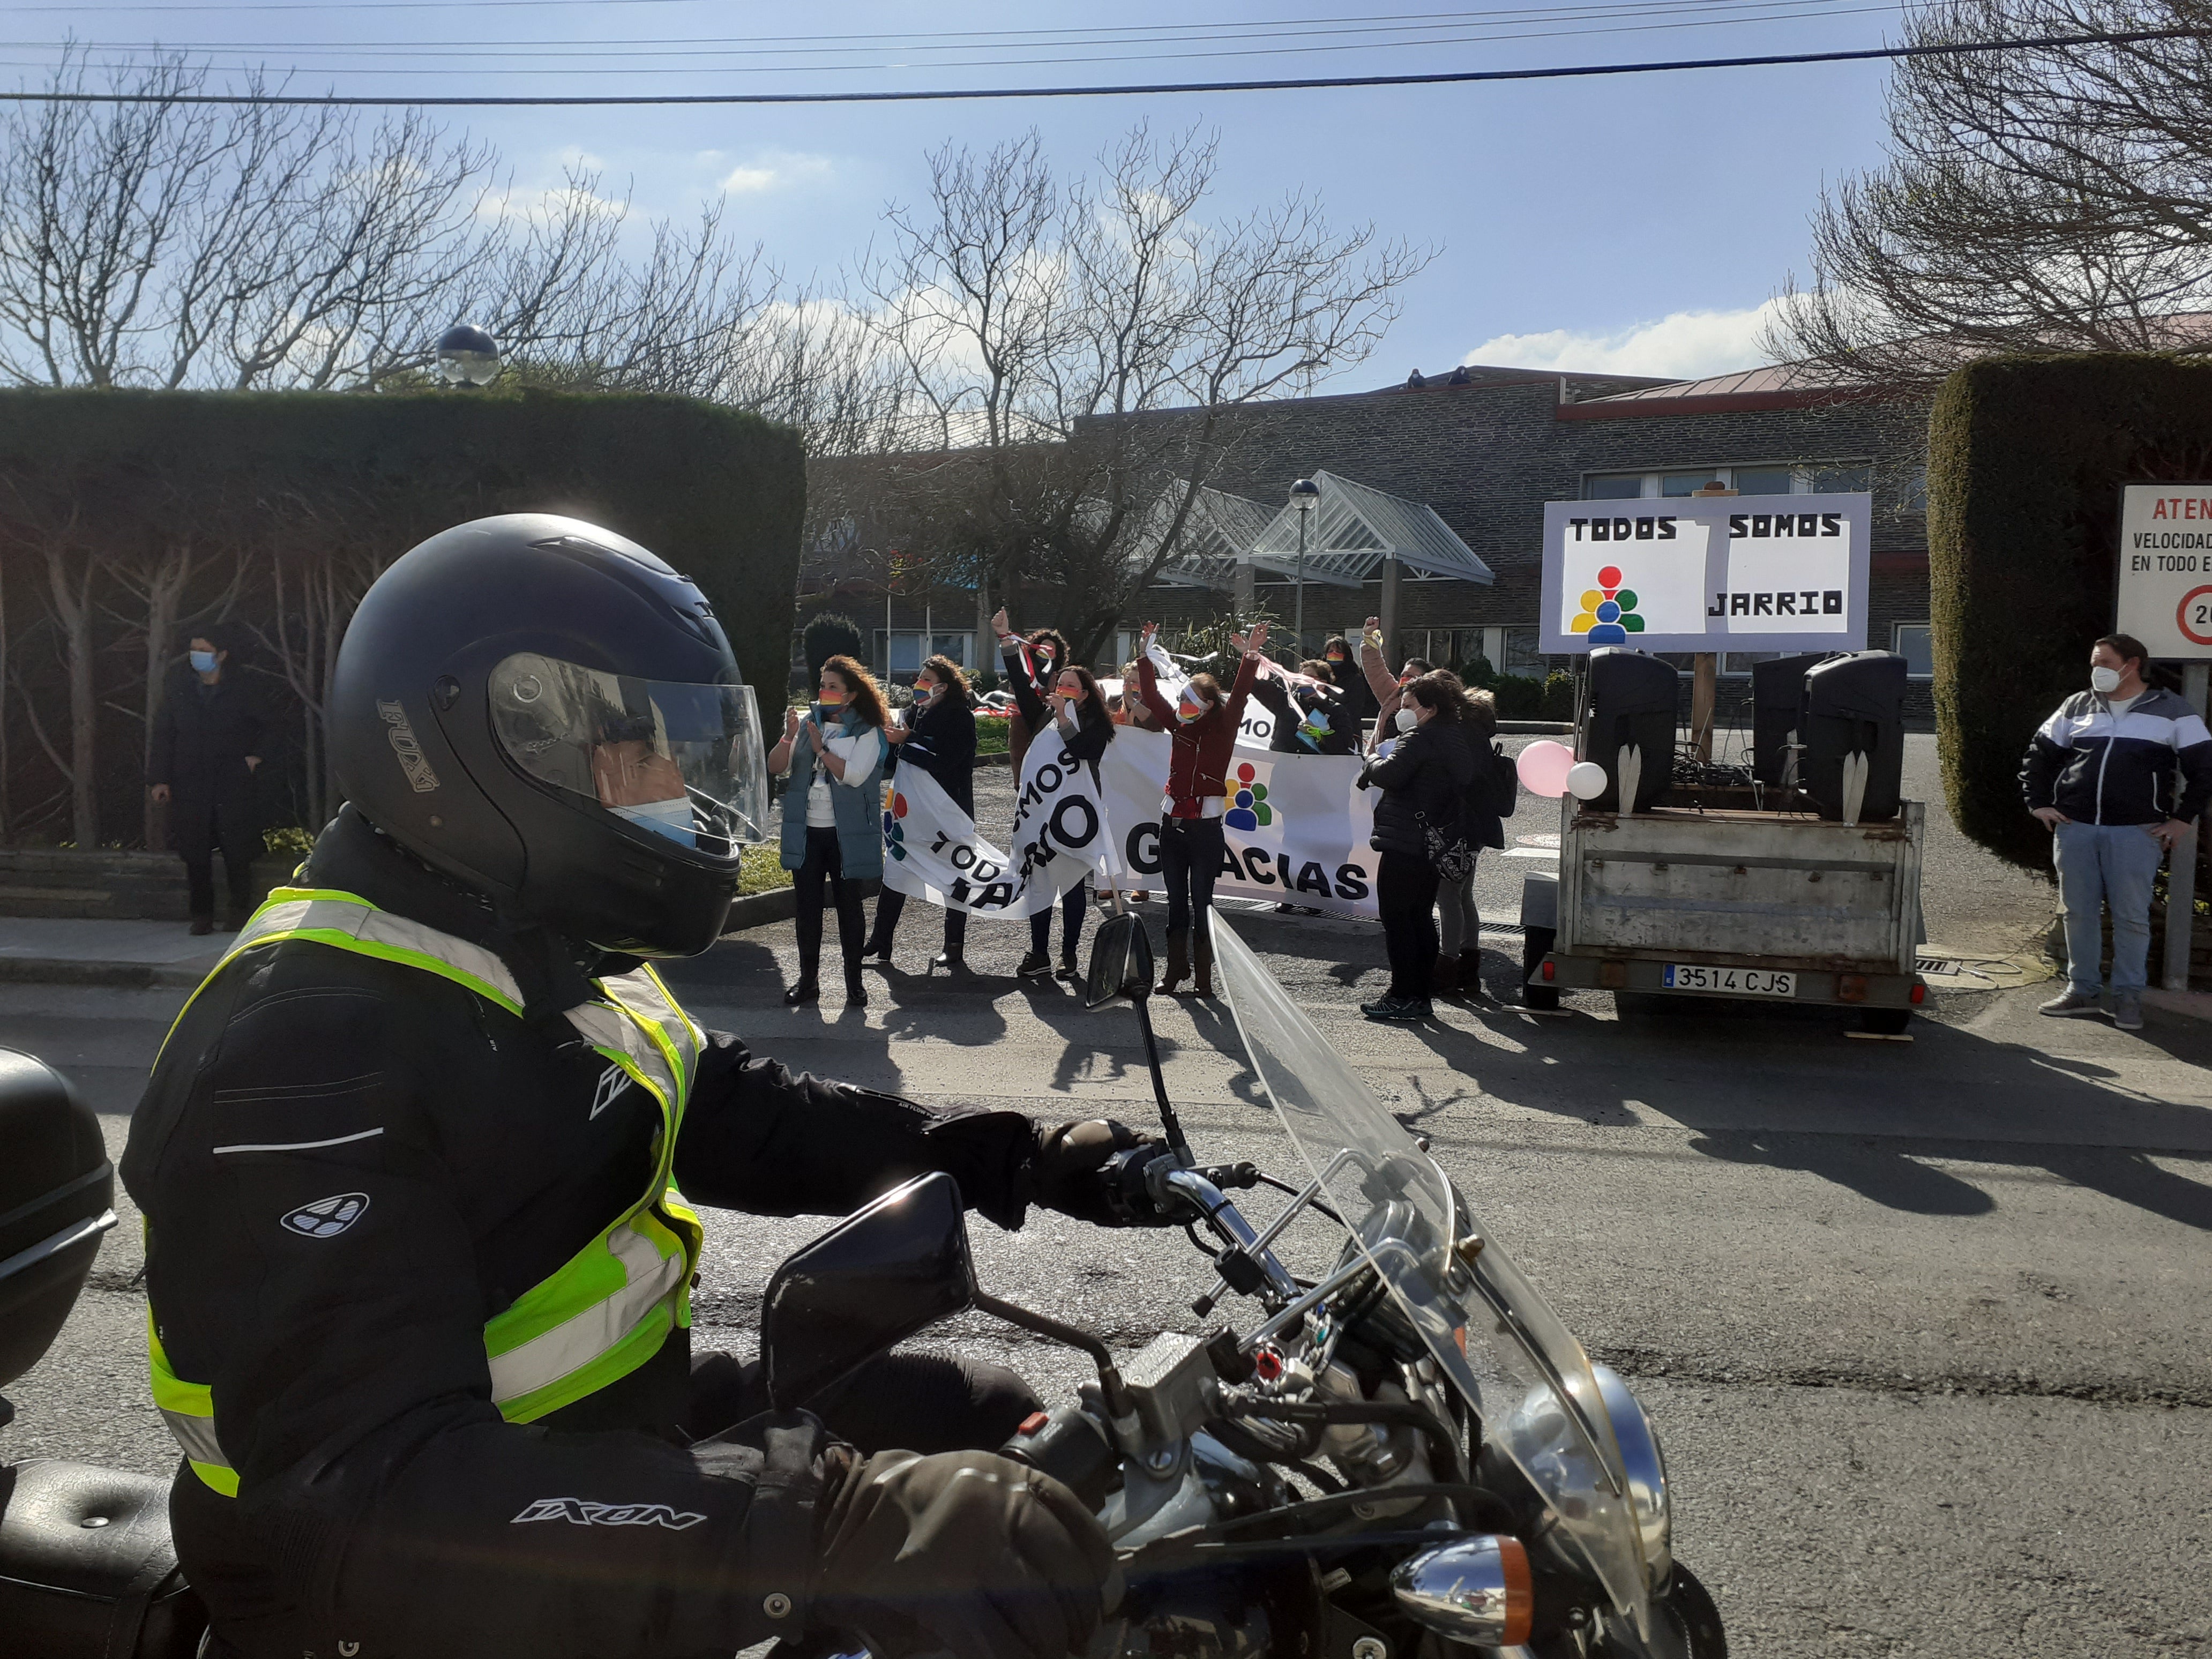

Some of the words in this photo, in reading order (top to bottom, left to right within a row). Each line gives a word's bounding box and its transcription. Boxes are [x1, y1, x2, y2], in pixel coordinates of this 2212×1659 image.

[1570, 517, 1677, 541] TODOS
[1729, 513, 1842, 538] SOMOS
[2133, 533, 2212, 549] VELOCIDAD
[2132, 556, 2151, 571] EN
[2157, 555, 2196, 572] TODO
[2202, 556, 2212, 572] E
[1708, 591, 1842, 616] JARRIO
[2195, 605, 2212, 624] 2
[1126, 822, 1369, 900] GACIAS
[1679, 968, 1736, 990] 3514
[1746, 972, 1790, 993] CJS
